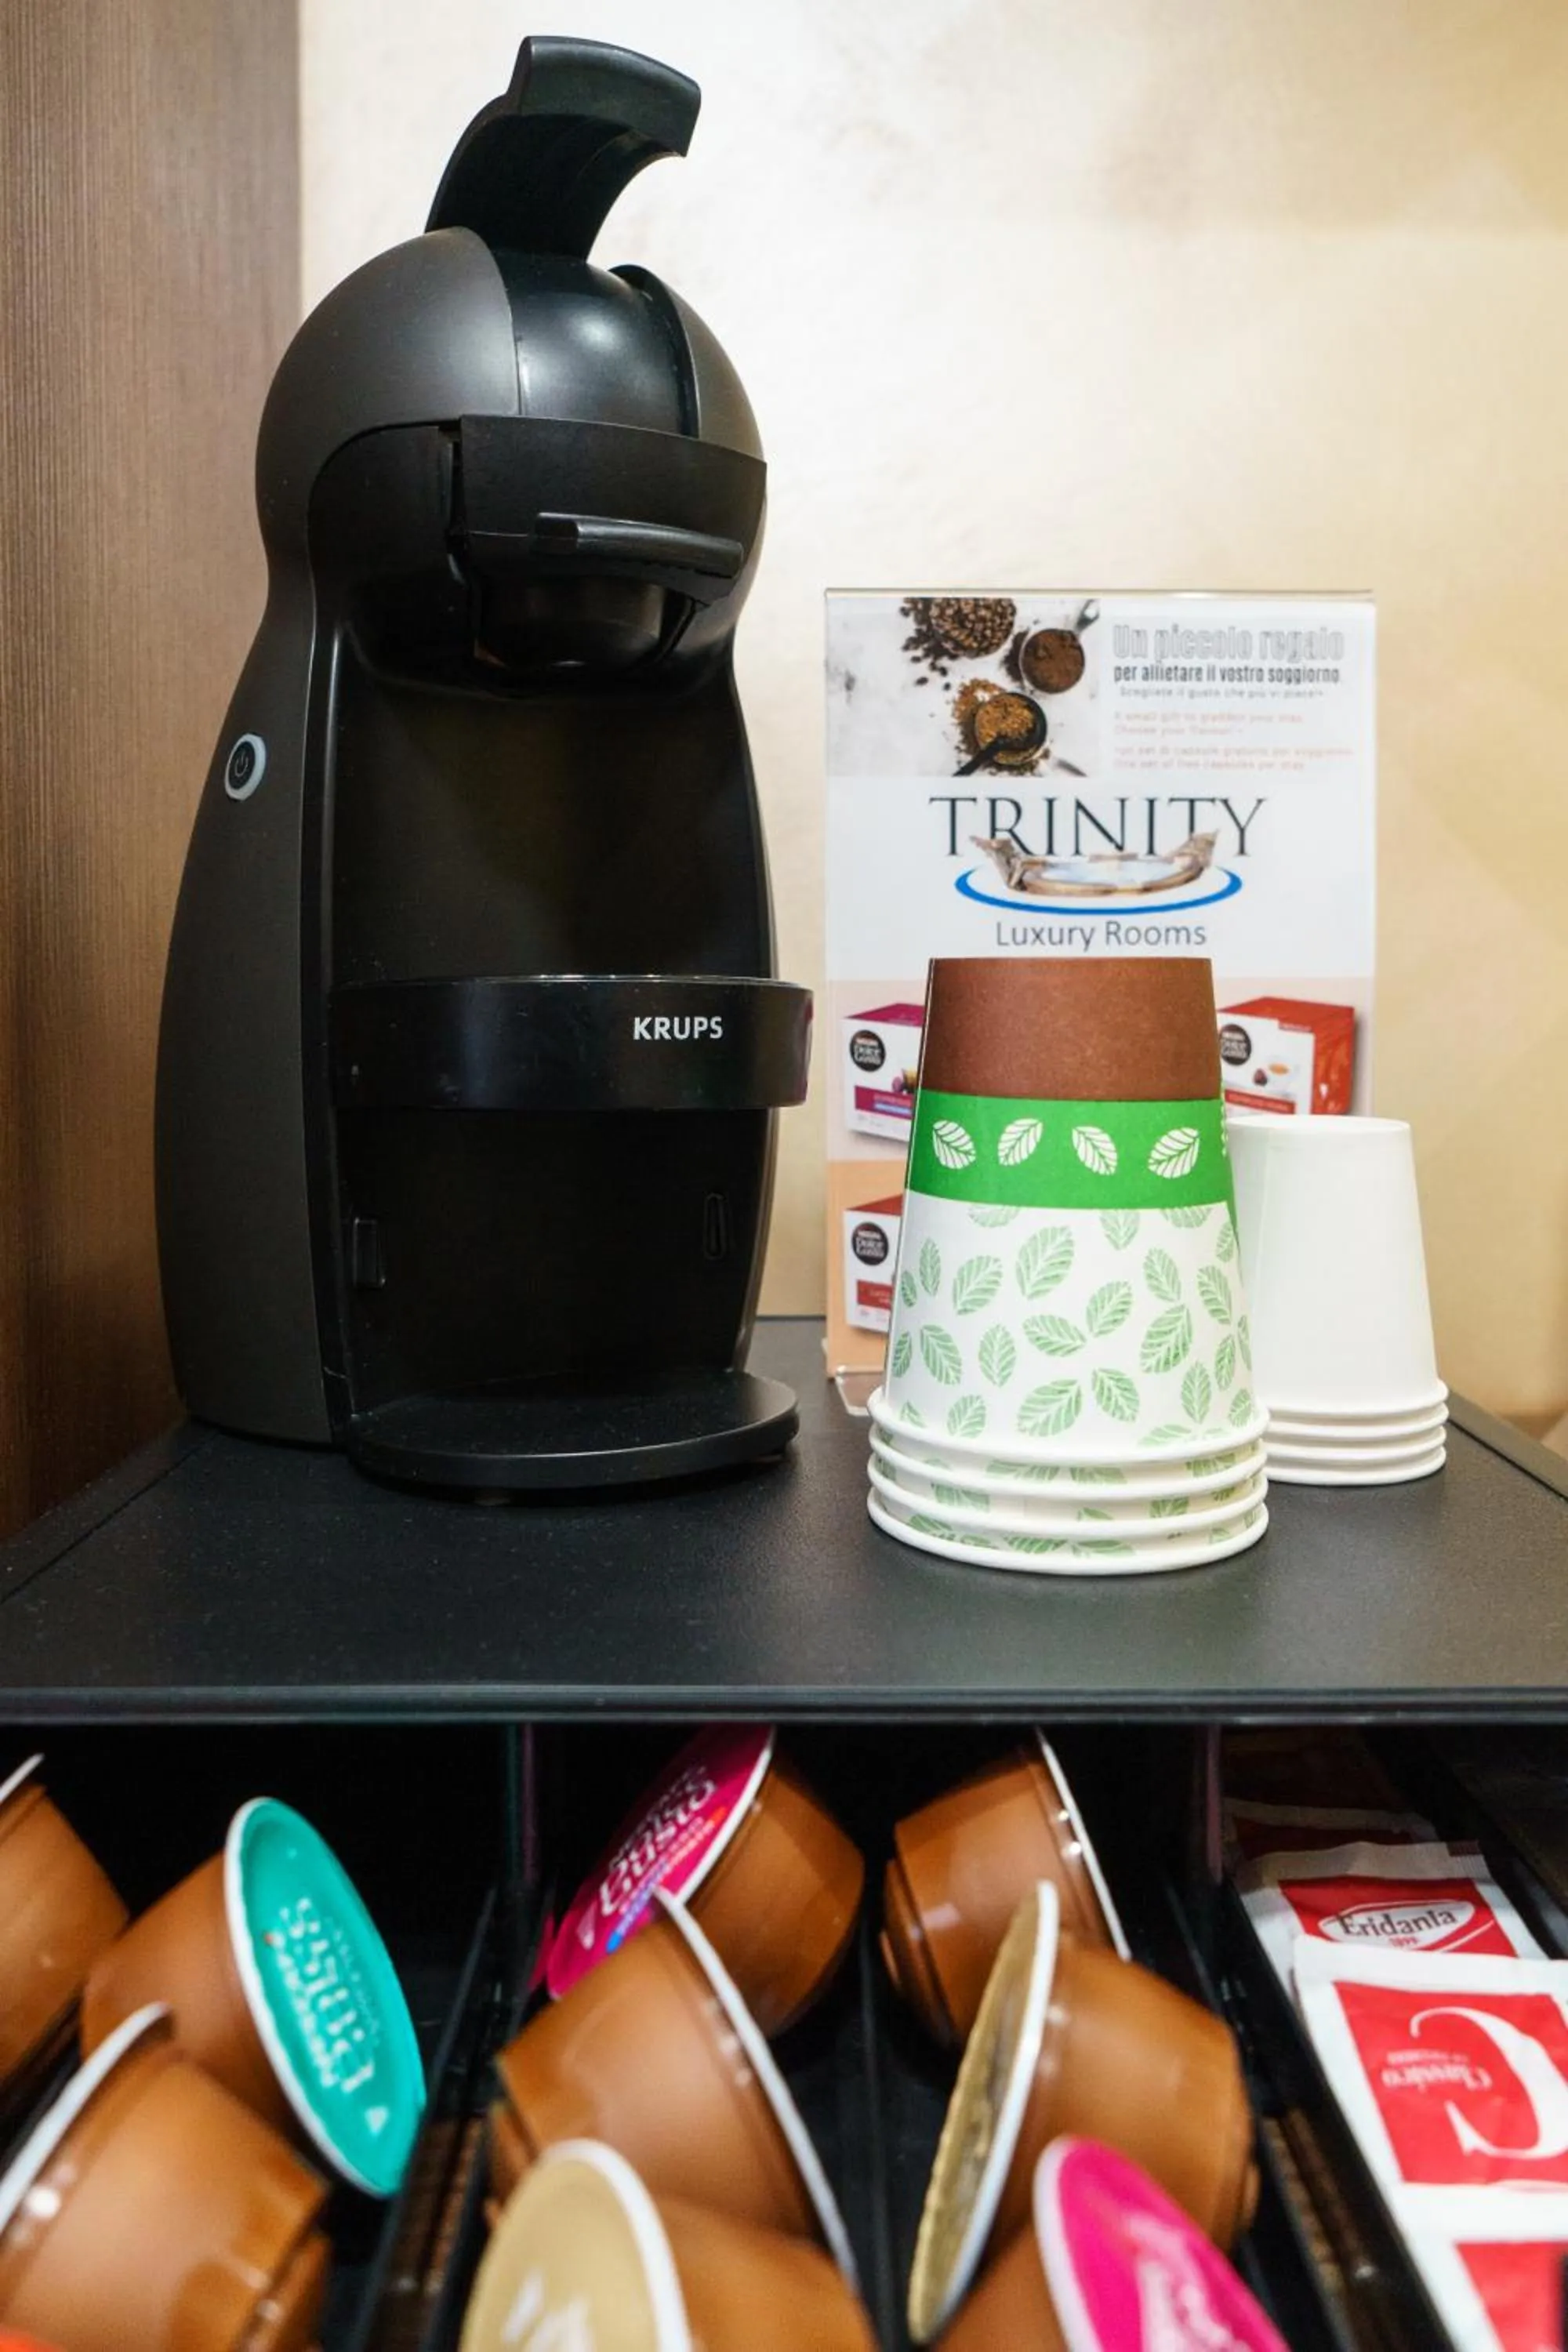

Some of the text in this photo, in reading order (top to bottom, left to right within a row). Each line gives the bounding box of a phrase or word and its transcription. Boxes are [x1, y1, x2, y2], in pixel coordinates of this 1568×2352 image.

[1112, 624, 1345, 663] Un piccolo regalo
[1114, 663, 1341, 684] per allietare il vostro soggiorno
[929, 797, 1268, 856] TRINITY
[996, 920, 1207, 952] Luxury Rooms
[633, 1016, 723, 1040] KRUPS
